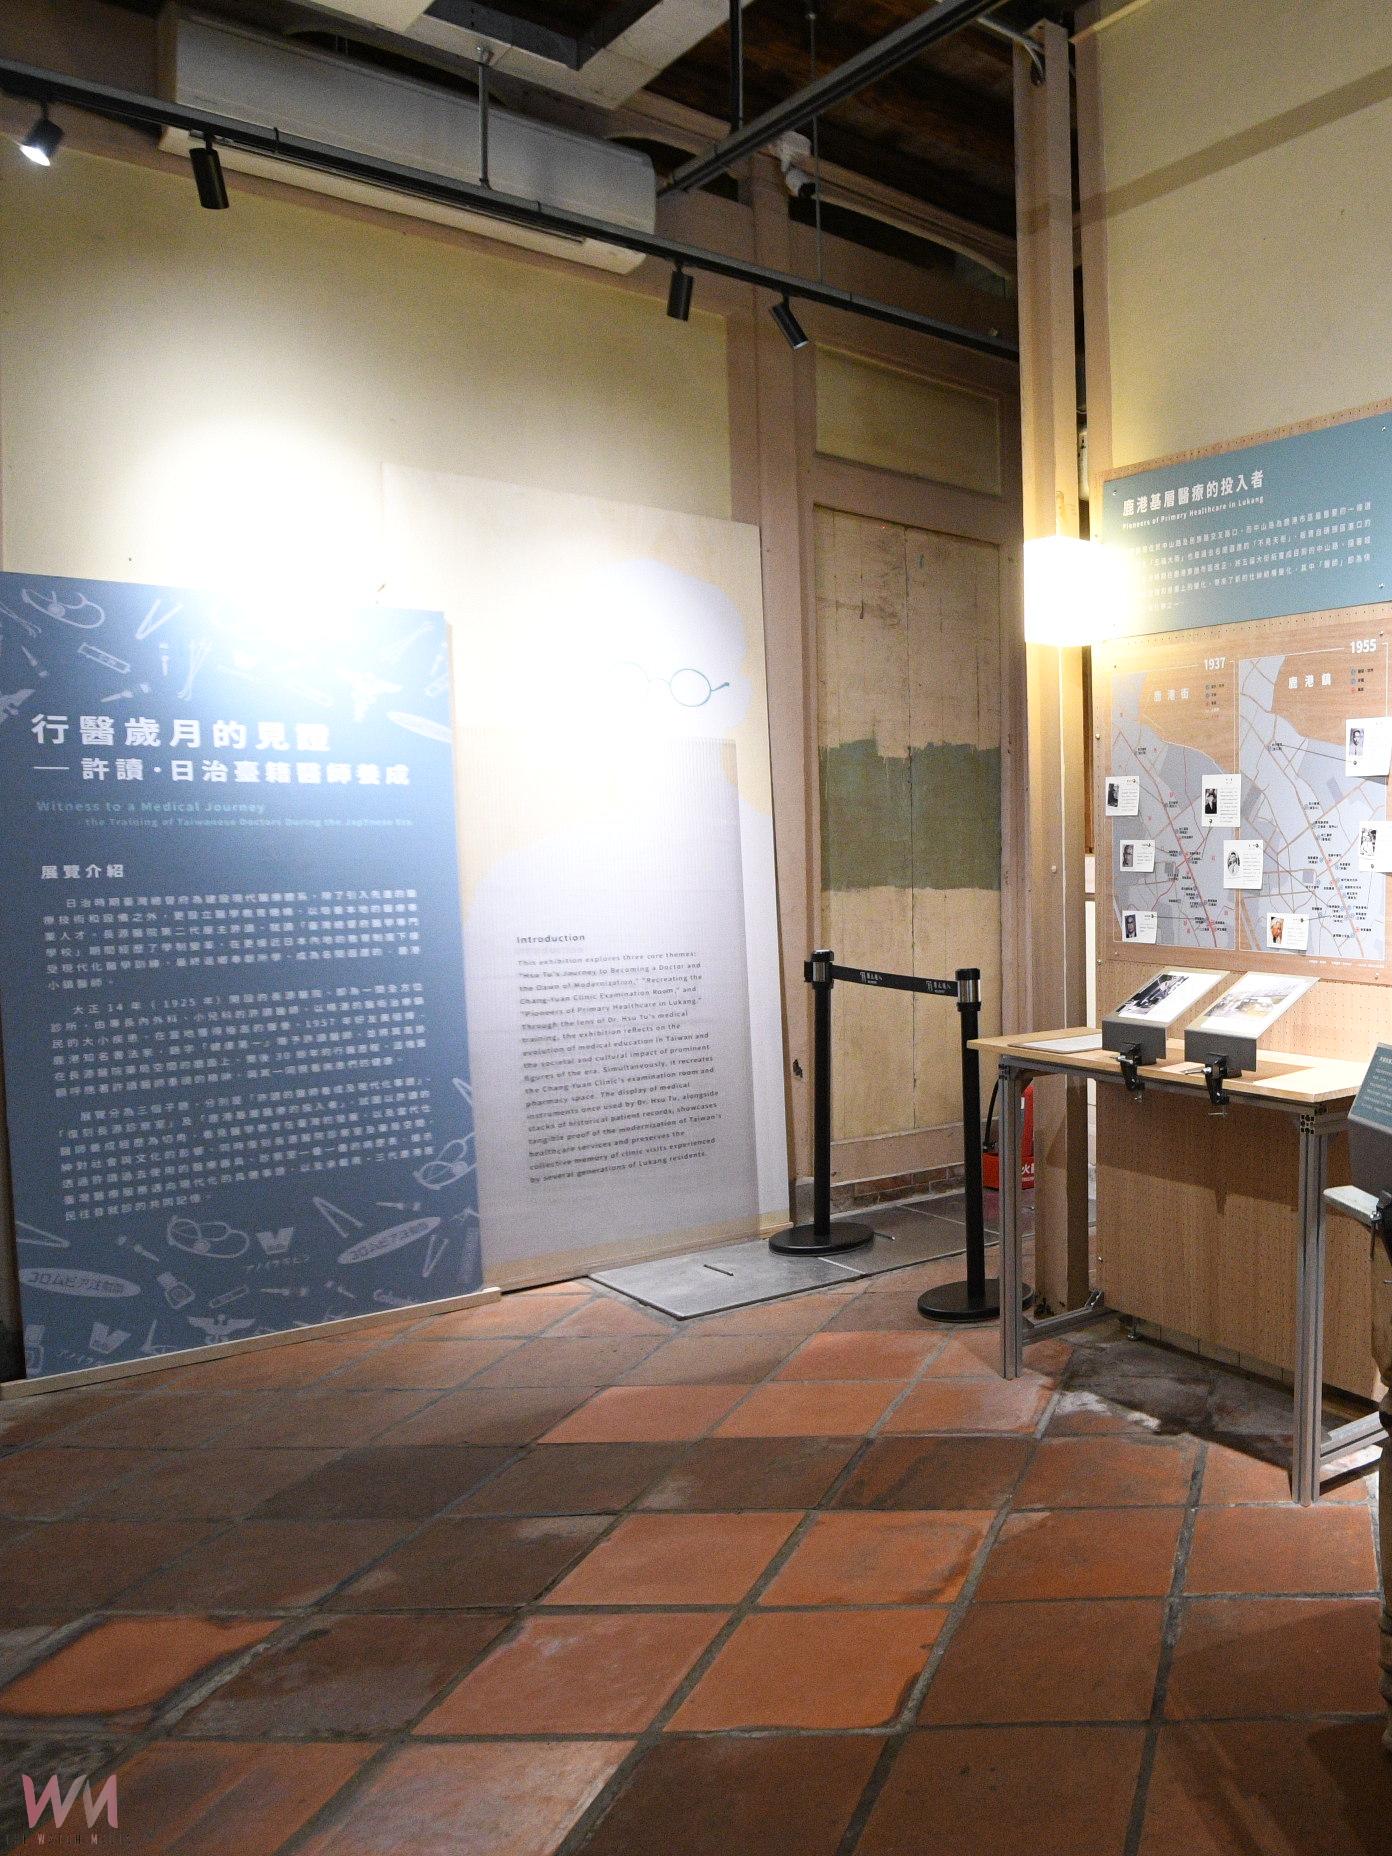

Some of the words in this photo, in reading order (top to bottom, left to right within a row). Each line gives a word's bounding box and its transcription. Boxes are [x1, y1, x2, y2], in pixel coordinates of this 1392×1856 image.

[1123, 470, 1264, 516] 鹿港基層醫療的投入者
[1189, 503, 1227, 517] Healthcare
[1350, 639, 1377, 653] 1955
[1204, 657, 1226, 670] 1937
[36, 801, 100, 812] Witness
[106, 802, 121, 812] to
[142, 801, 200, 812] Medical
[205, 803, 265, 814] Journey
[41, 864, 124, 879] 展覽介紹
[516, 933, 585, 943] Introduction
